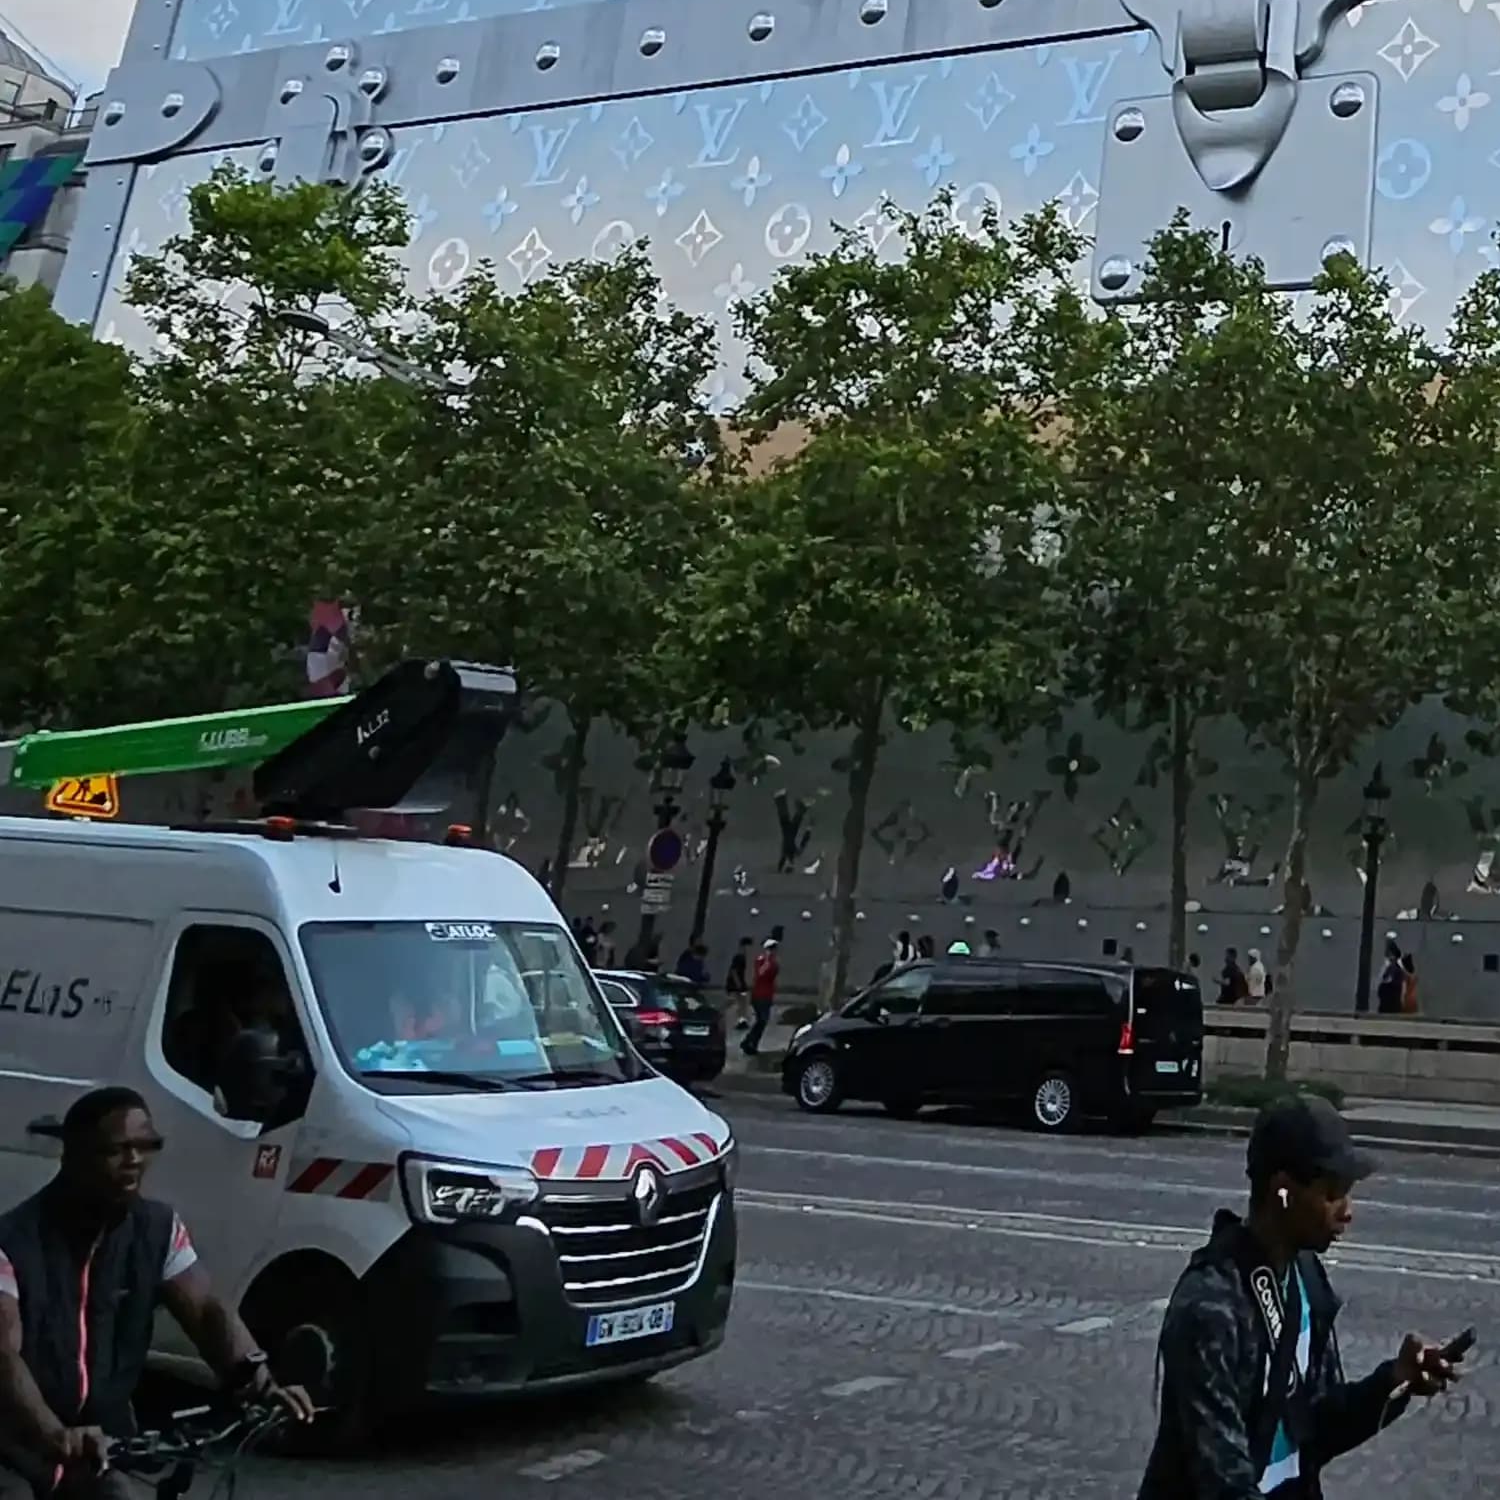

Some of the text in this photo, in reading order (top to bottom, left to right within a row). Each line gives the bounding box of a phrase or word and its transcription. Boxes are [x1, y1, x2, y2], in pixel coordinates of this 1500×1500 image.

[864, 74, 927, 147] LV
[1055, 49, 1121, 126] LV
[523, 118, 579, 187] LV
[687, 97, 747, 168] LV
